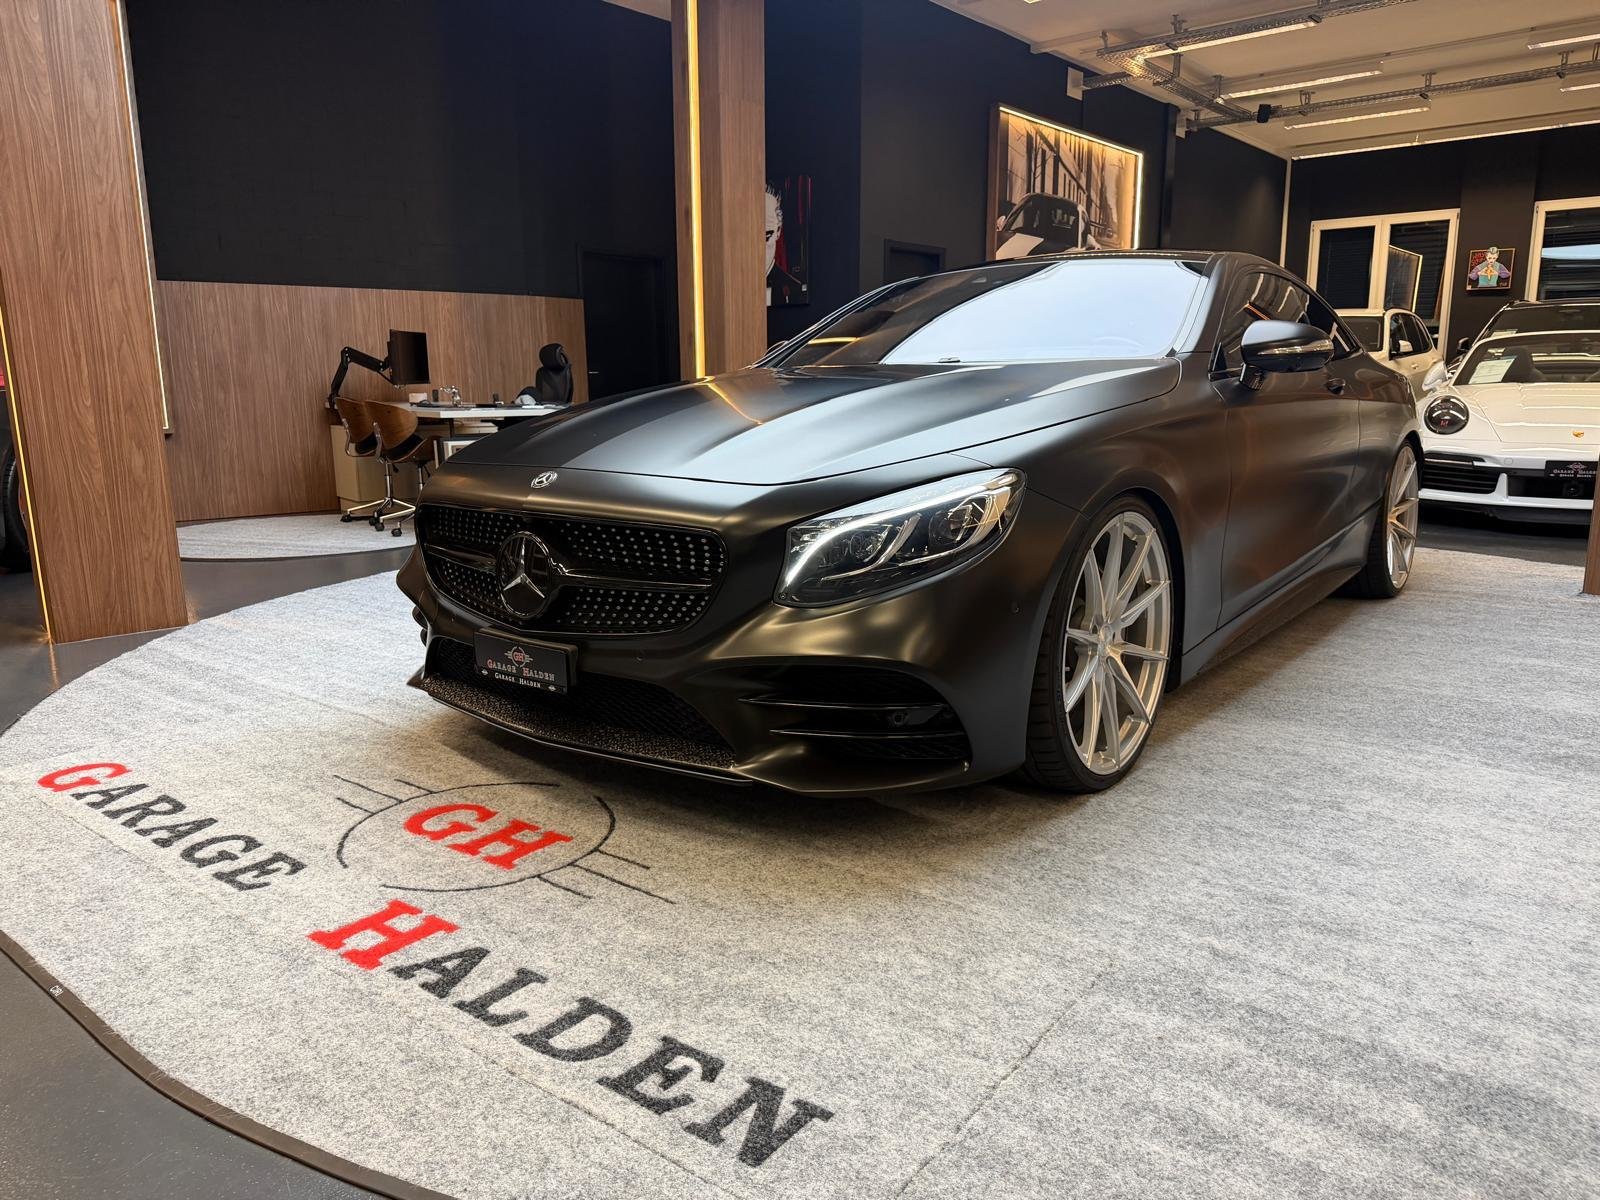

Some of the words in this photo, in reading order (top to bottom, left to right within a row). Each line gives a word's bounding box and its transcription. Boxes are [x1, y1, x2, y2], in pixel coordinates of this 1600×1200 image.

[486, 659, 517, 673] GARAGE
[522, 667, 555, 682] HALDEN
[513, 651, 524, 662] GH
[494, 671, 516, 683] GARAGE
[519, 677, 541, 689] HALDEN
[37, 762, 305, 892] GARAGE
[403, 802, 574, 871] GH
[308, 898, 834, 1168] HALDEN
